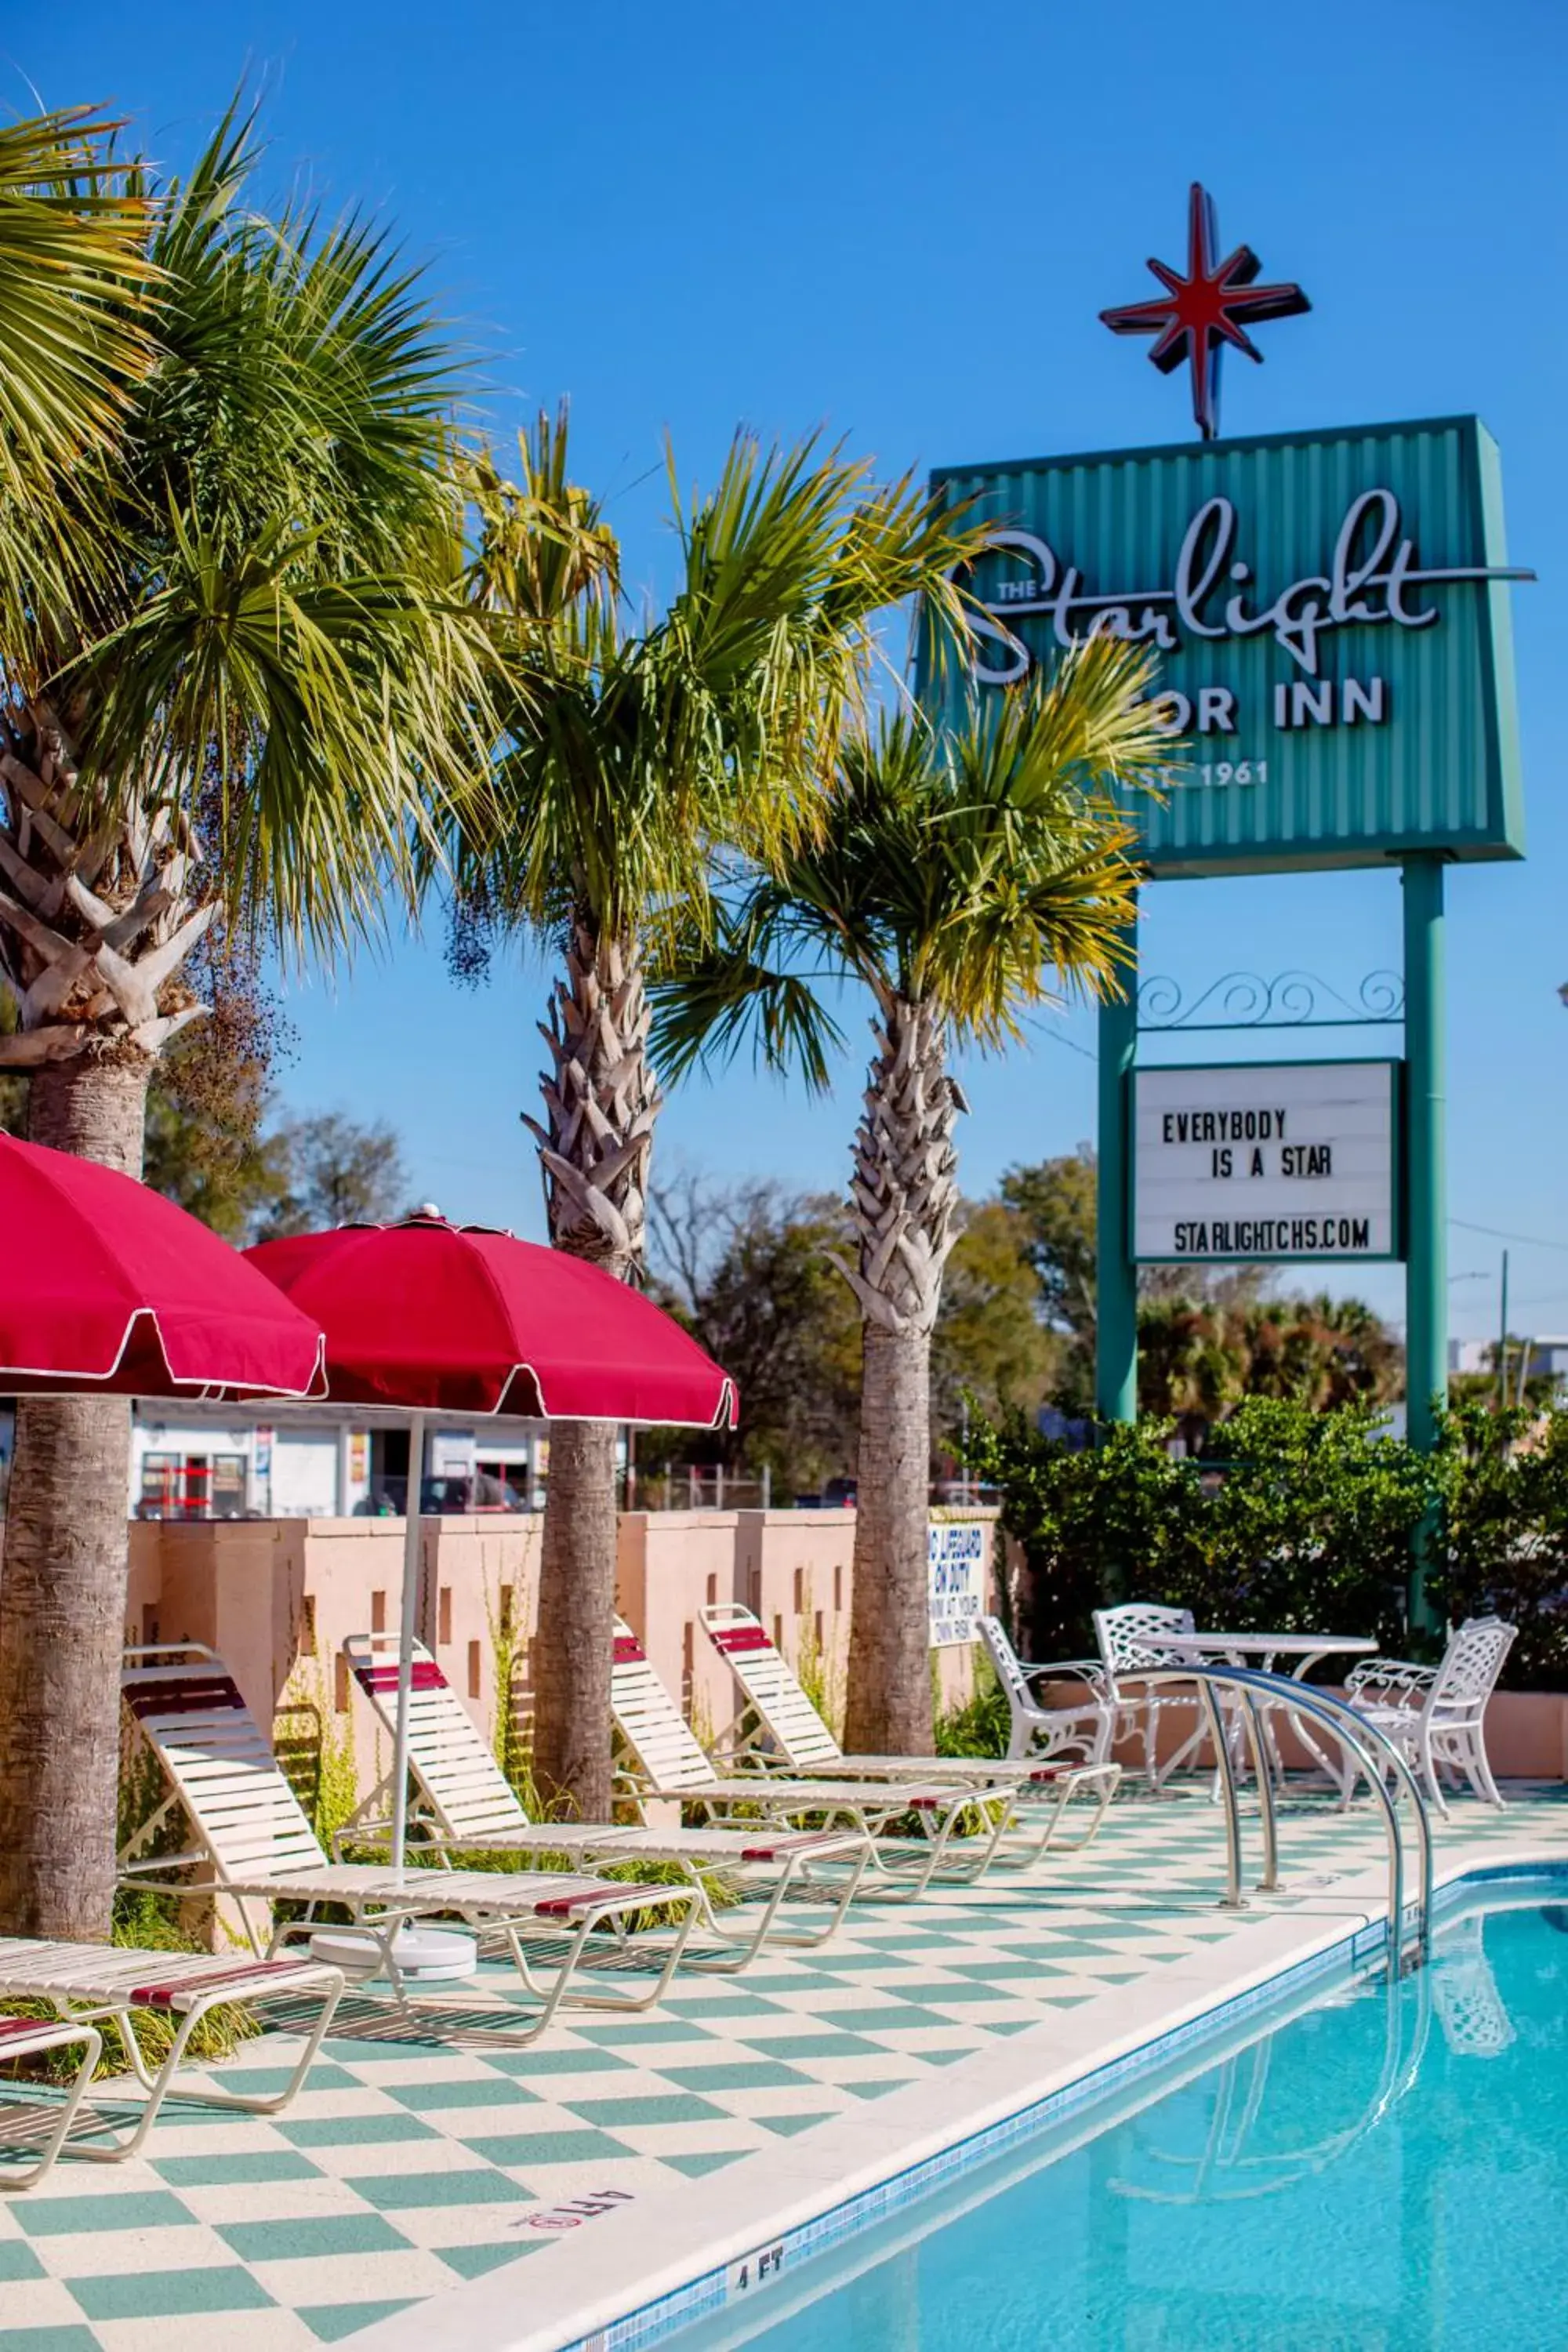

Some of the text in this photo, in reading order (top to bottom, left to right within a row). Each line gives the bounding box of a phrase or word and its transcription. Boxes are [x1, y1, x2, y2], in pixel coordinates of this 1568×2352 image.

[944, 488, 1537, 684] Starlight
[997, 580, 1036, 600] THE
[1274, 677, 1384, 730] INN
[1200, 760, 1268, 785] 1961
[1163, 1109, 1286, 1143] EVERYBODY
[1212, 1145, 1331, 1178] IS A STAR
[1174, 1218, 1369, 1253] STARLIGHTCHS.COM
[736, 2245, 782, 2289] 4 FT
